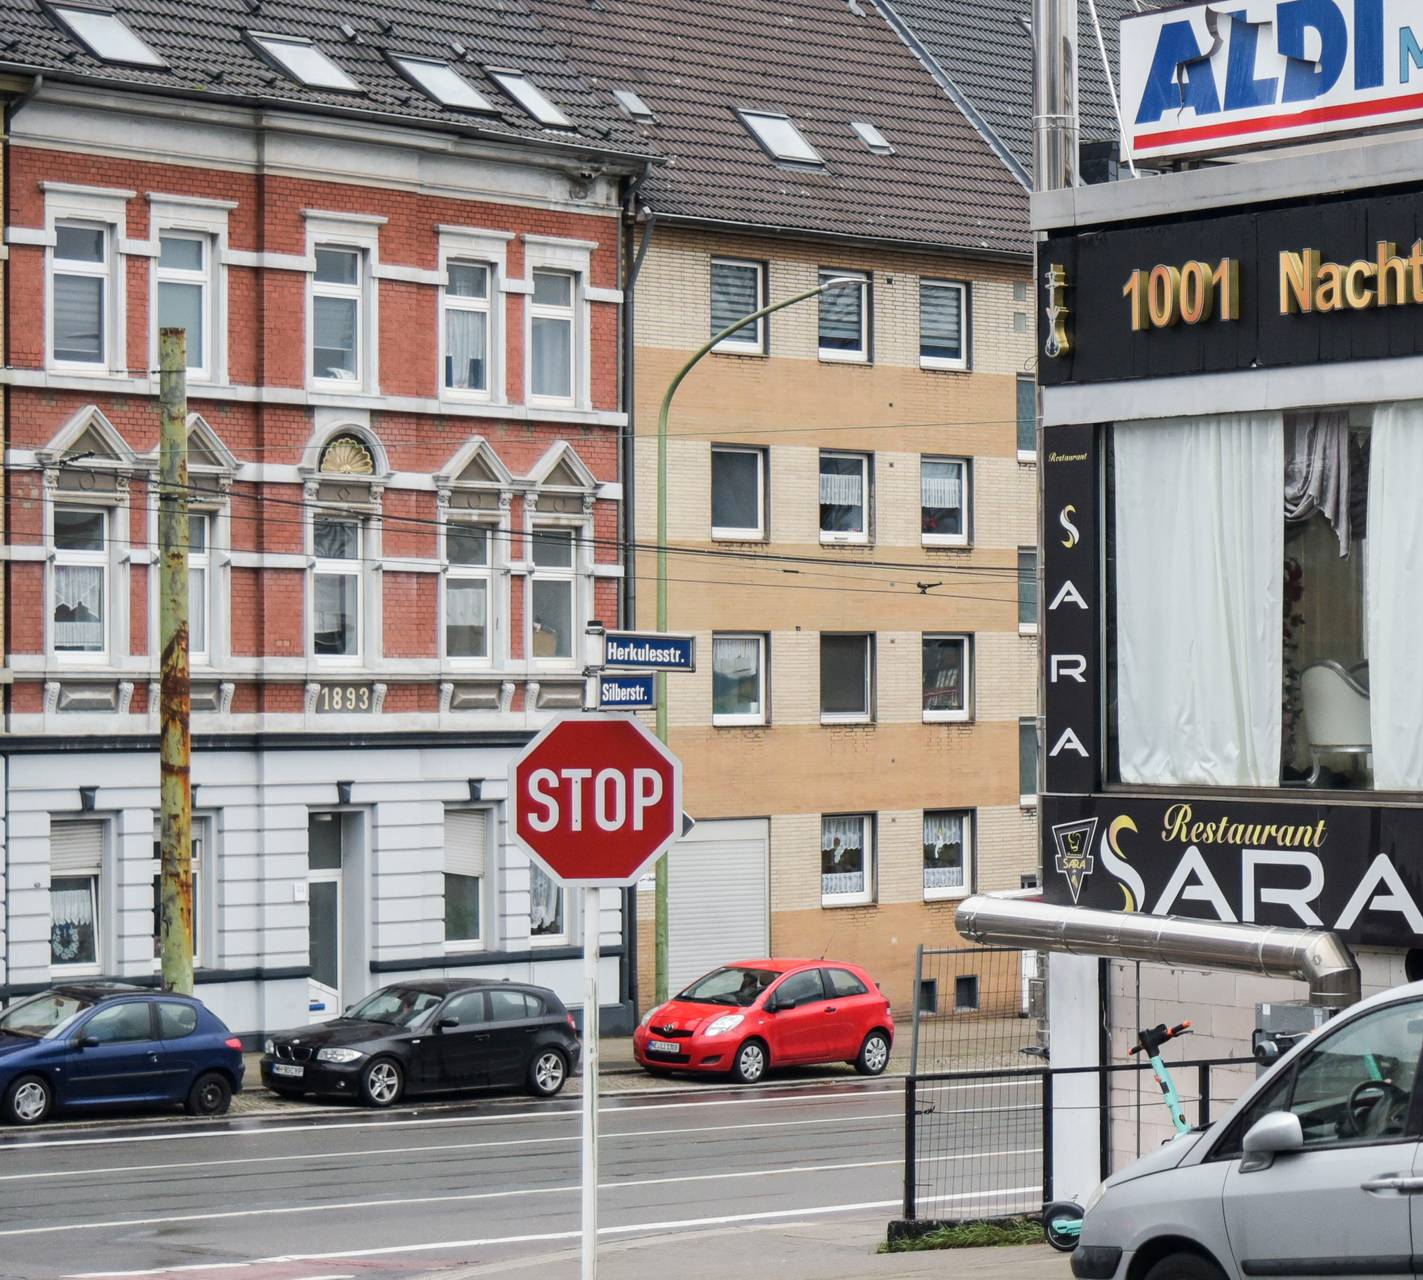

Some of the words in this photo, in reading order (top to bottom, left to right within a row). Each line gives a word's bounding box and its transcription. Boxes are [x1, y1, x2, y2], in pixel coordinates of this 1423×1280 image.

[1135, 0, 1384, 124] ALDI
[1122, 257, 1240, 332] 1001
[1048, 451, 1088, 462] Restaurant
[607, 641, 685, 664] Herkulesstr.
[321, 687, 369, 710] 1893
[602, 683, 648, 701] Silberstr.
[527, 767, 664, 833] STOP
[1161, 803, 1329, 848] Restaurant
[1063, 858, 1087, 870] SARA
